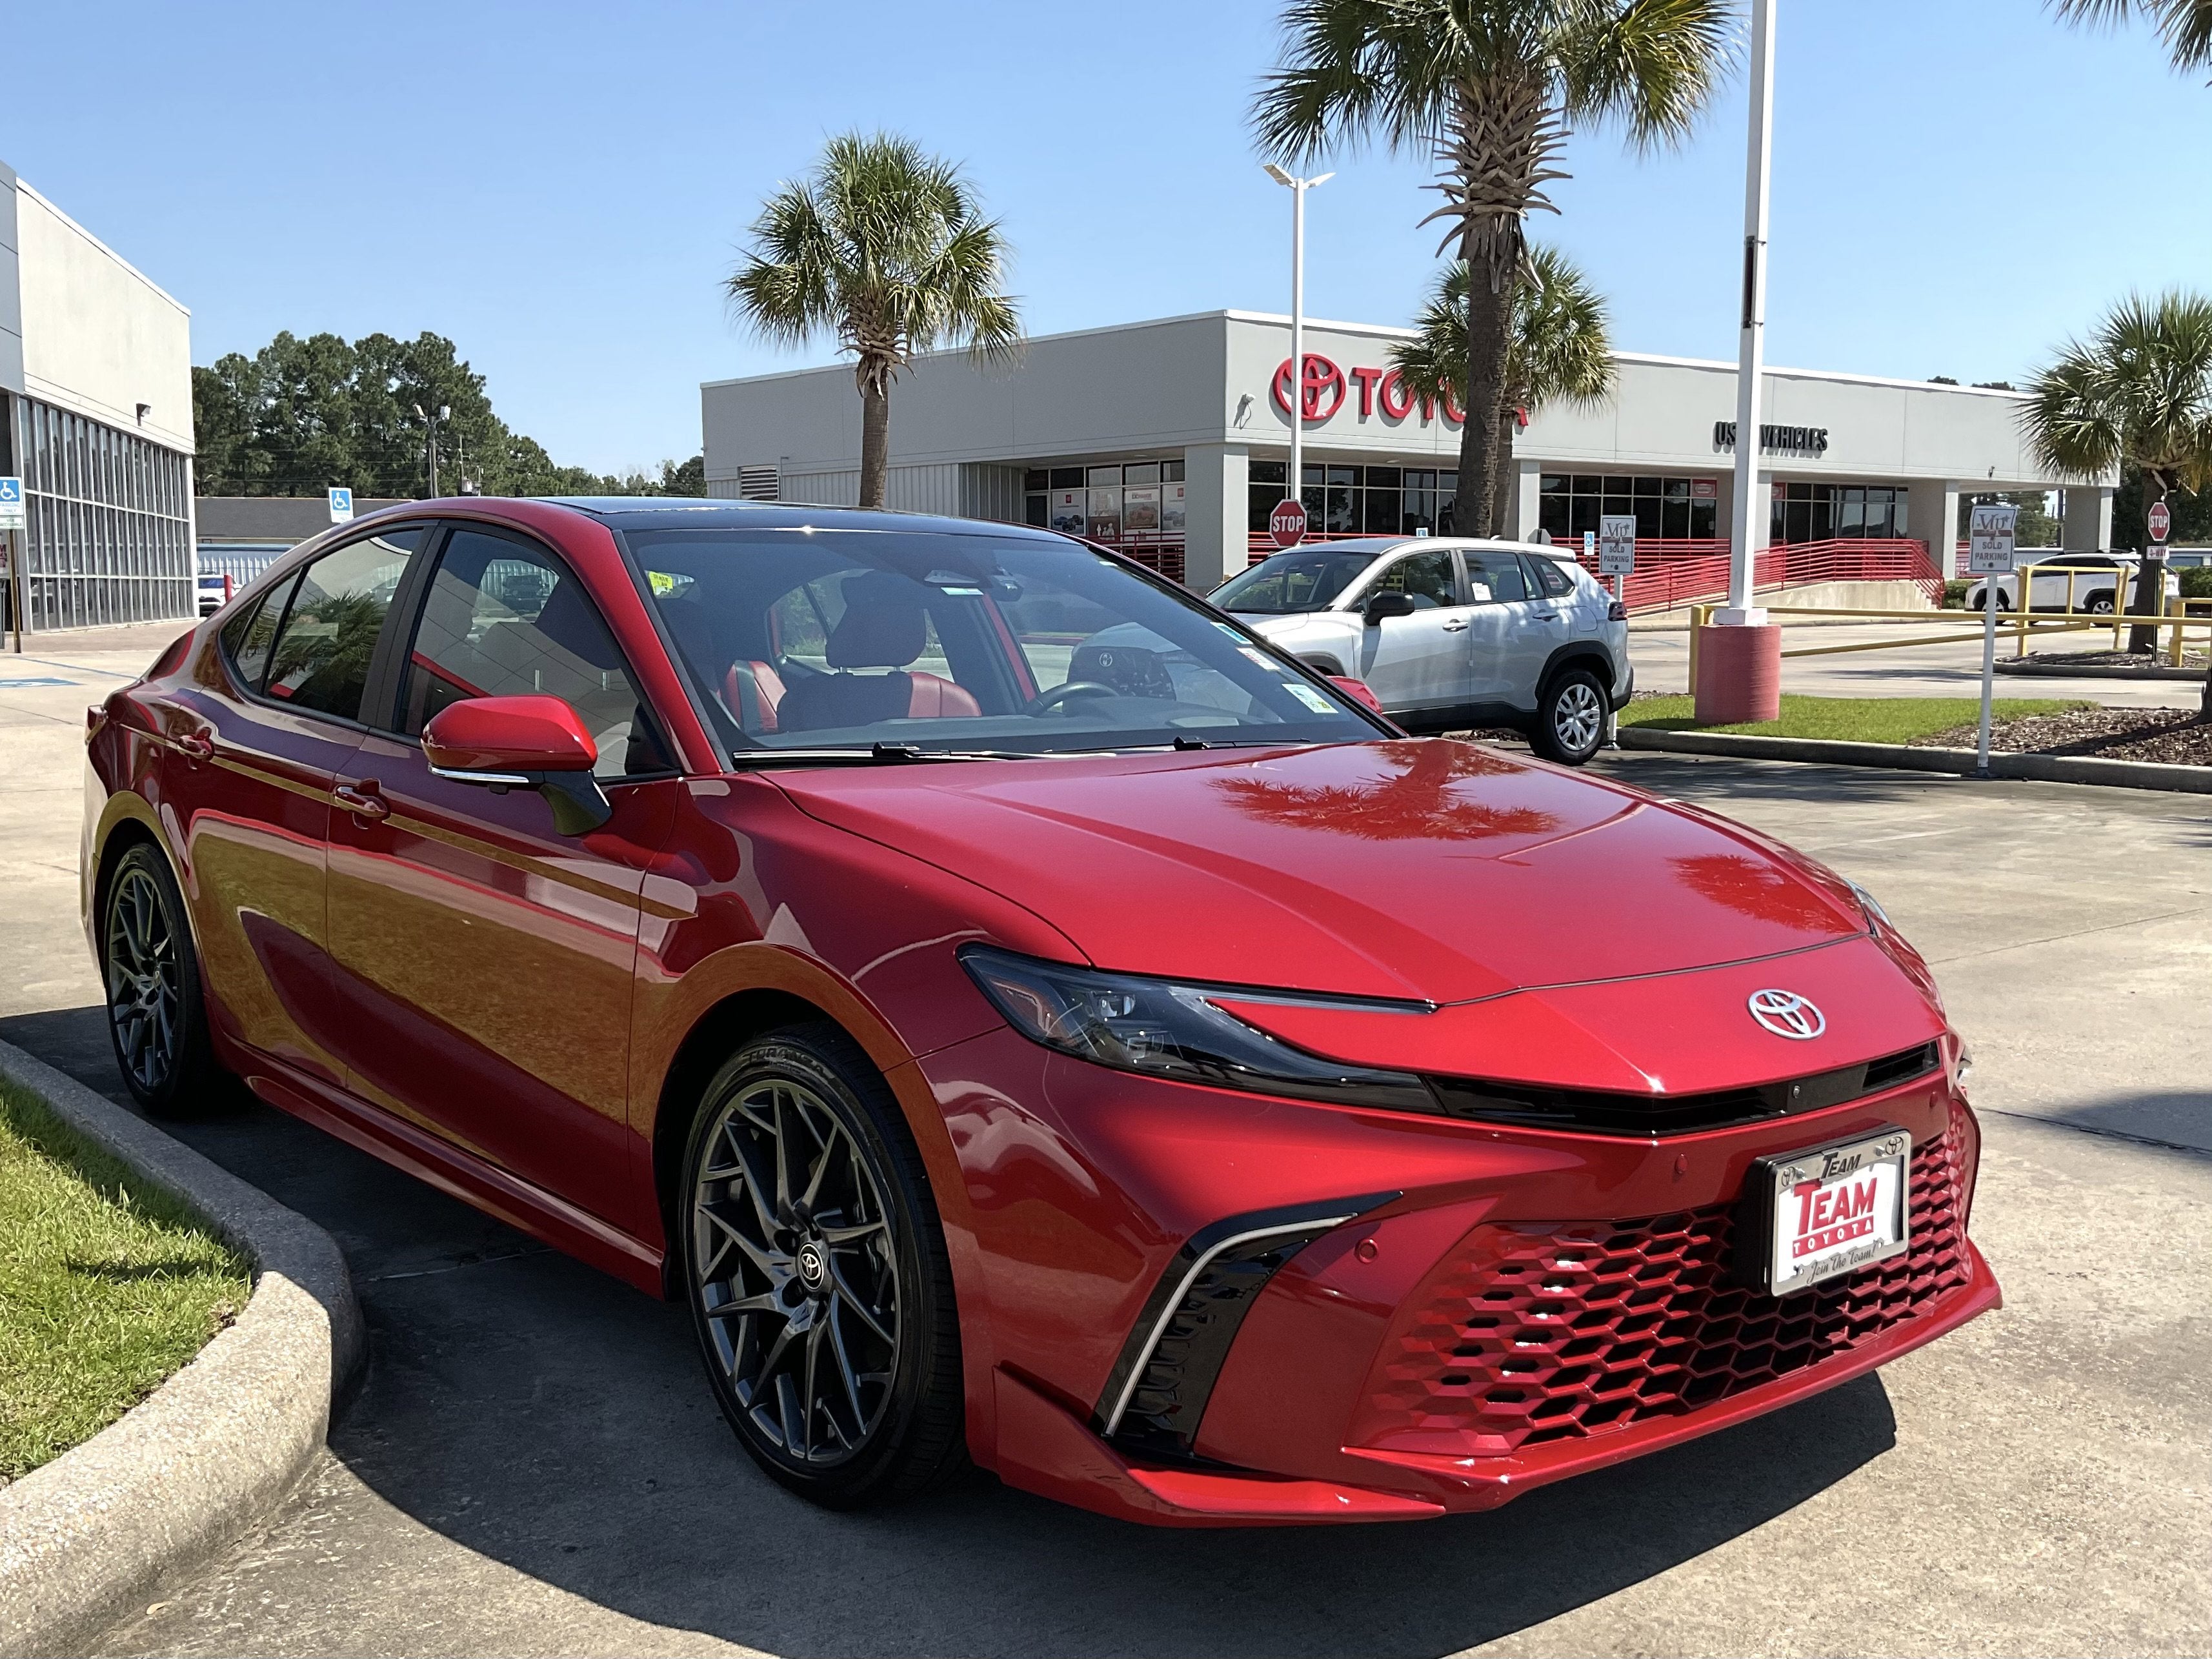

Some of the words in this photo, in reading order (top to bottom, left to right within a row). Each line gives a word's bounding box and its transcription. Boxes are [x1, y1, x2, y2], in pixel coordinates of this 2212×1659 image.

[1715, 421, 1736, 445] US
[1760, 424, 1828, 451] VEHICLES
[1272, 515, 1303, 532] STOP
[2150, 515, 2168, 528] STOP
[1975, 552, 2008, 561] PARKING
[1982, 541, 2002, 550] SOLD
[2149, 548, 2167, 557] 4-WAY
[1820, 1152, 1862, 1179] TEAM
[1793, 1177, 1877, 1236] TEAM
[1793, 1219, 1873, 1254] TOYOTA
[1807, 1262, 1828, 1284] Join
[1831, 1254, 1847, 1270] The
[1848, 1245, 1876, 1263] Team!
